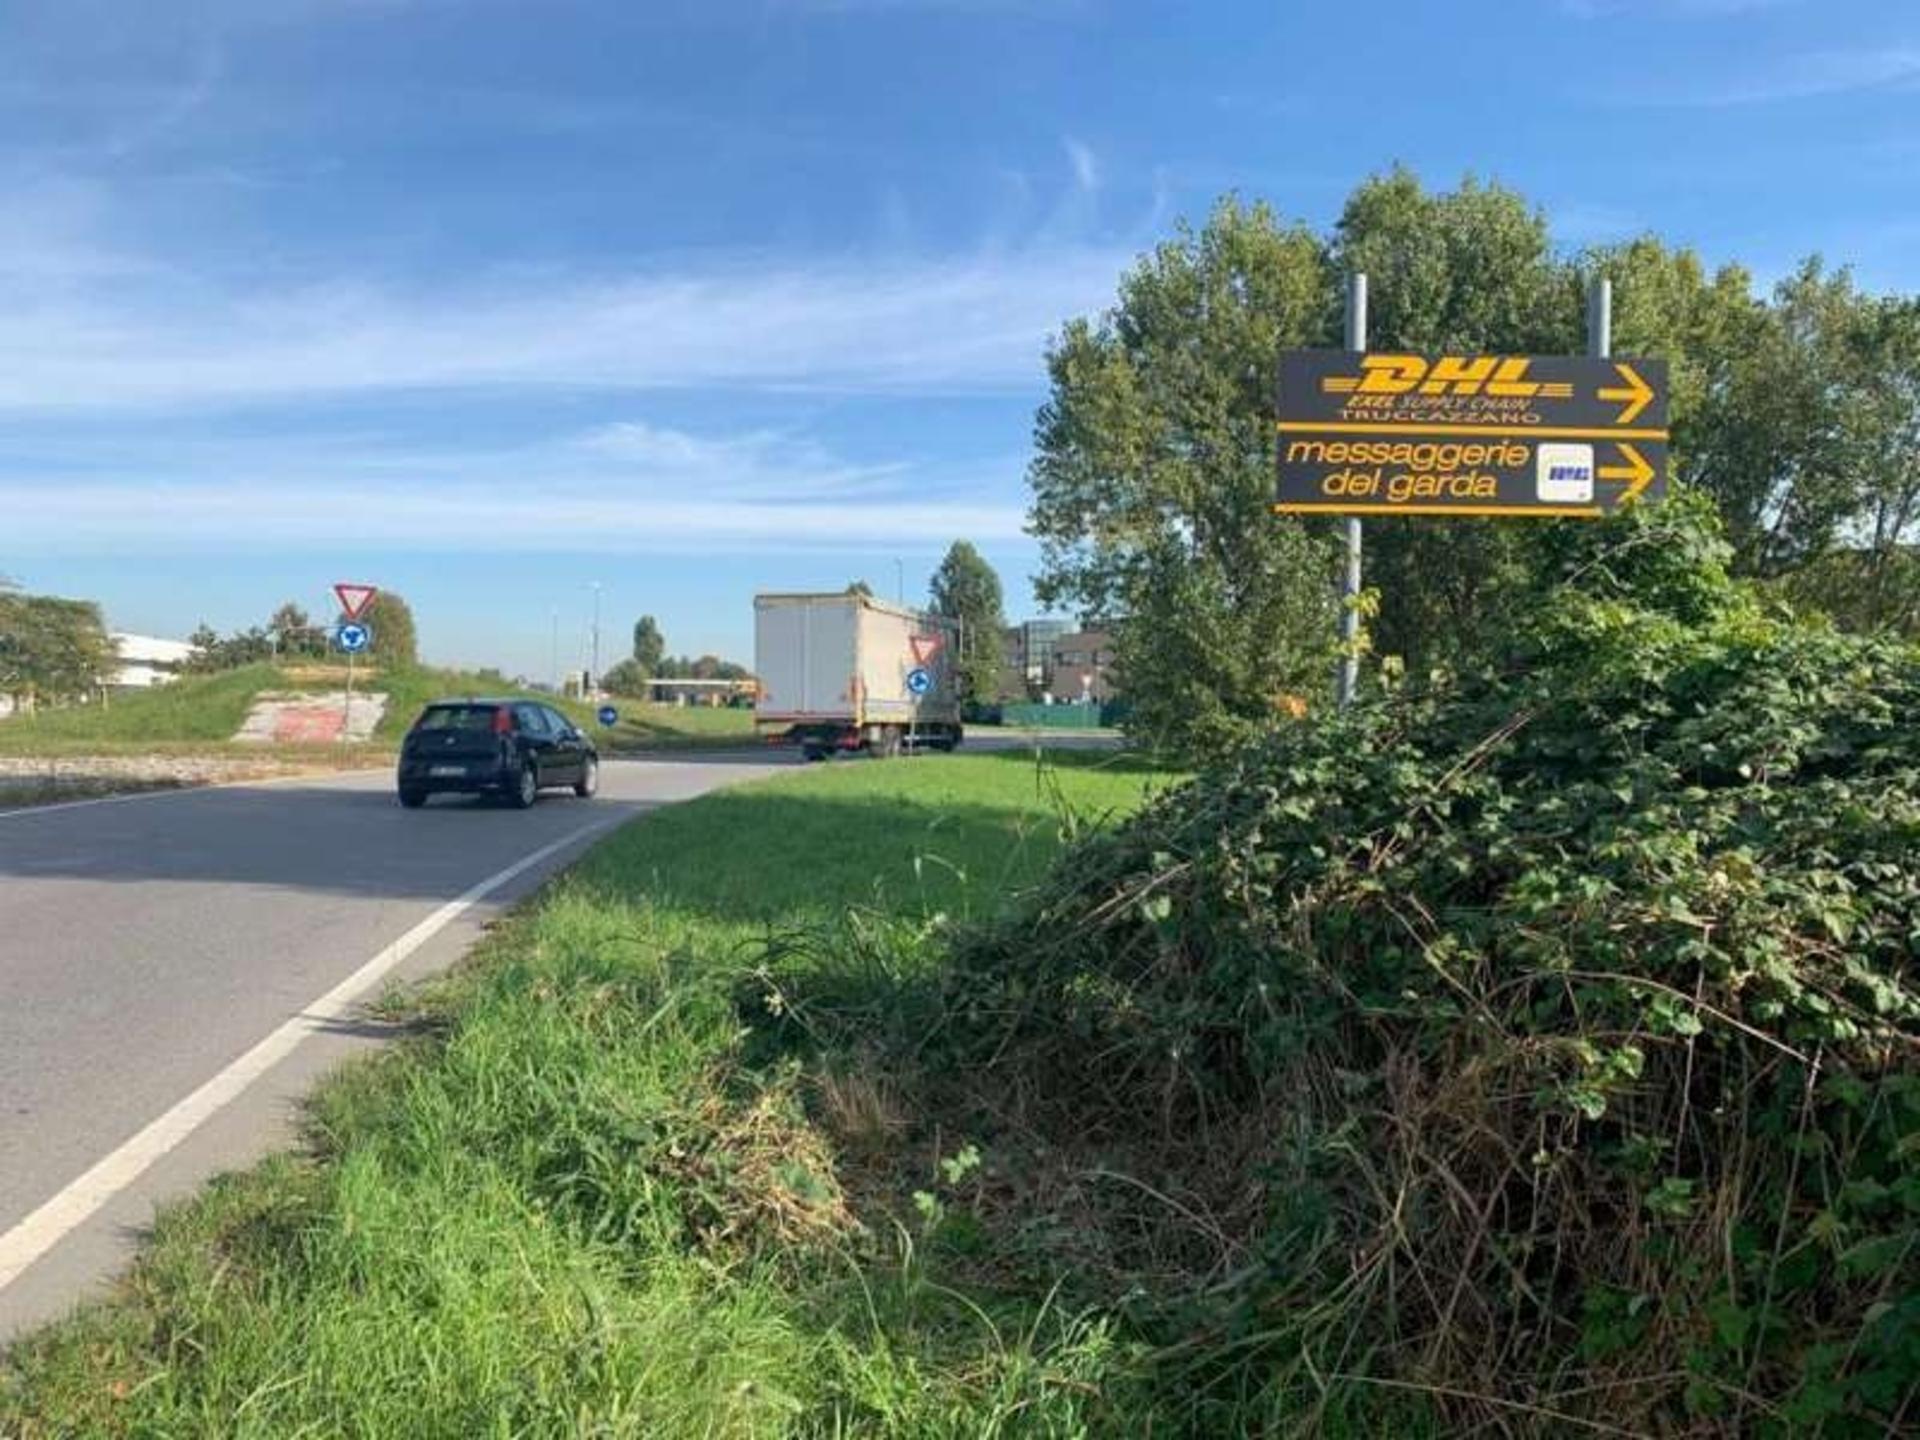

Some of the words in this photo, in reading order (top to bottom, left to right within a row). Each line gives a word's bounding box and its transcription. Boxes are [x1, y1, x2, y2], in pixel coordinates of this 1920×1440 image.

[1357, 354, 1540, 396] DHL
[1341, 409, 1541, 424] TRUCCAZZANO
[1286, 439, 1530, 472] messaggerie
[1322, 468, 1381, 496] del
[1386, 469, 1497, 502] garda
